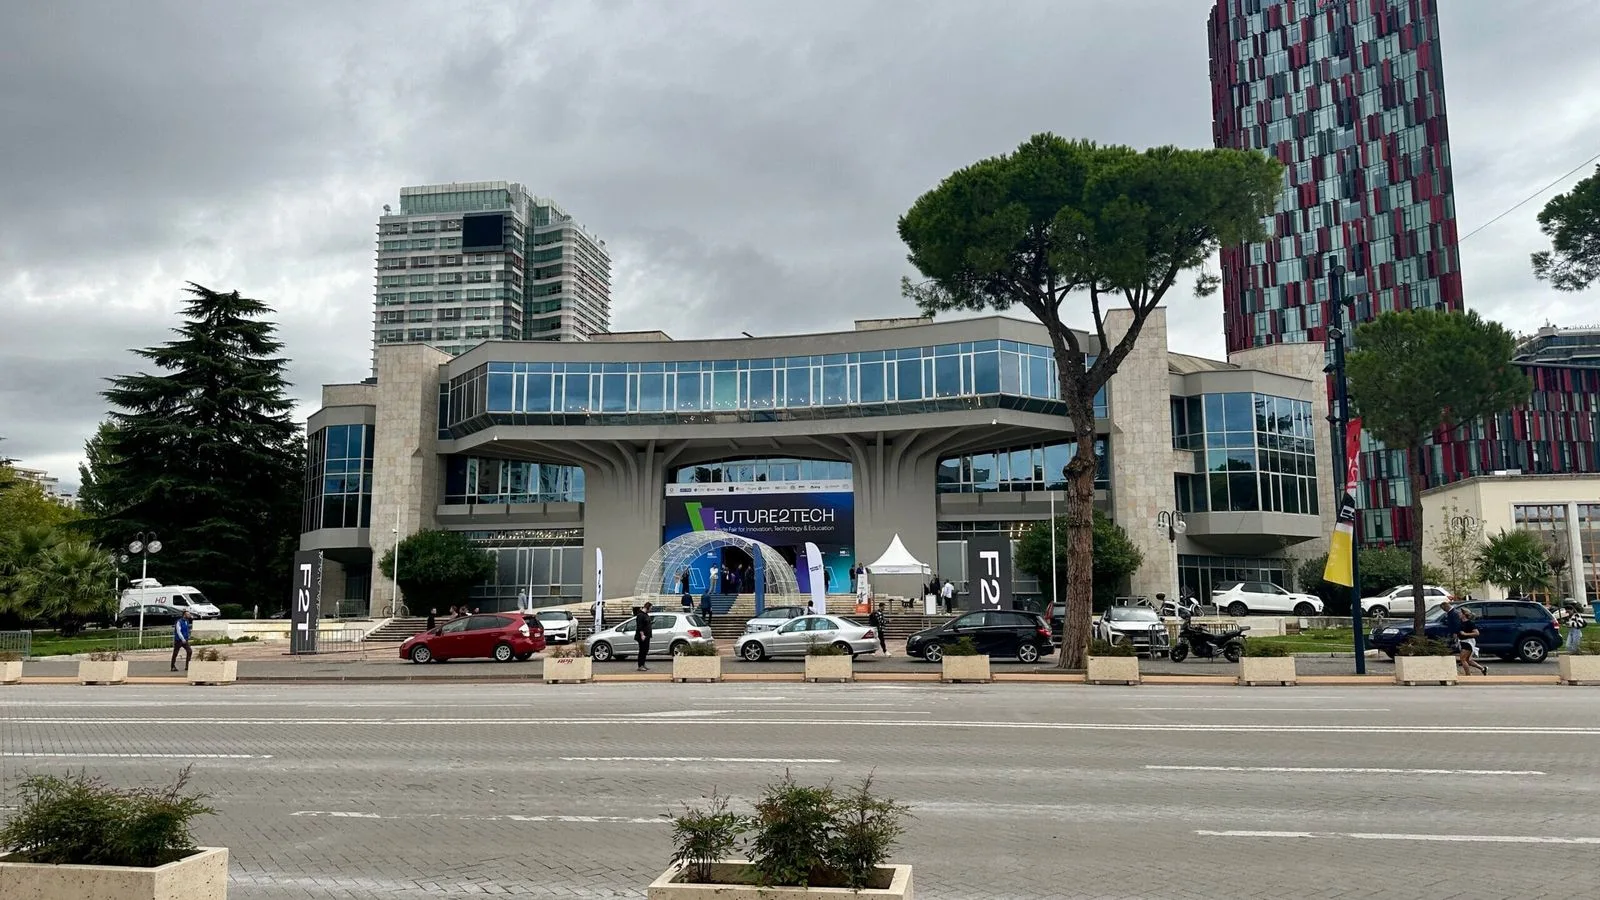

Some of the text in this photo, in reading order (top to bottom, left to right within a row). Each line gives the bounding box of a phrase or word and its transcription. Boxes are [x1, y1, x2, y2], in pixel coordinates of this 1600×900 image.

[714, 508, 835, 524] FUTURE2TECH
[979, 550, 1001, 611] F2
[155, 596, 167, 604] HD
[297, 563, 312, 641] F2T
